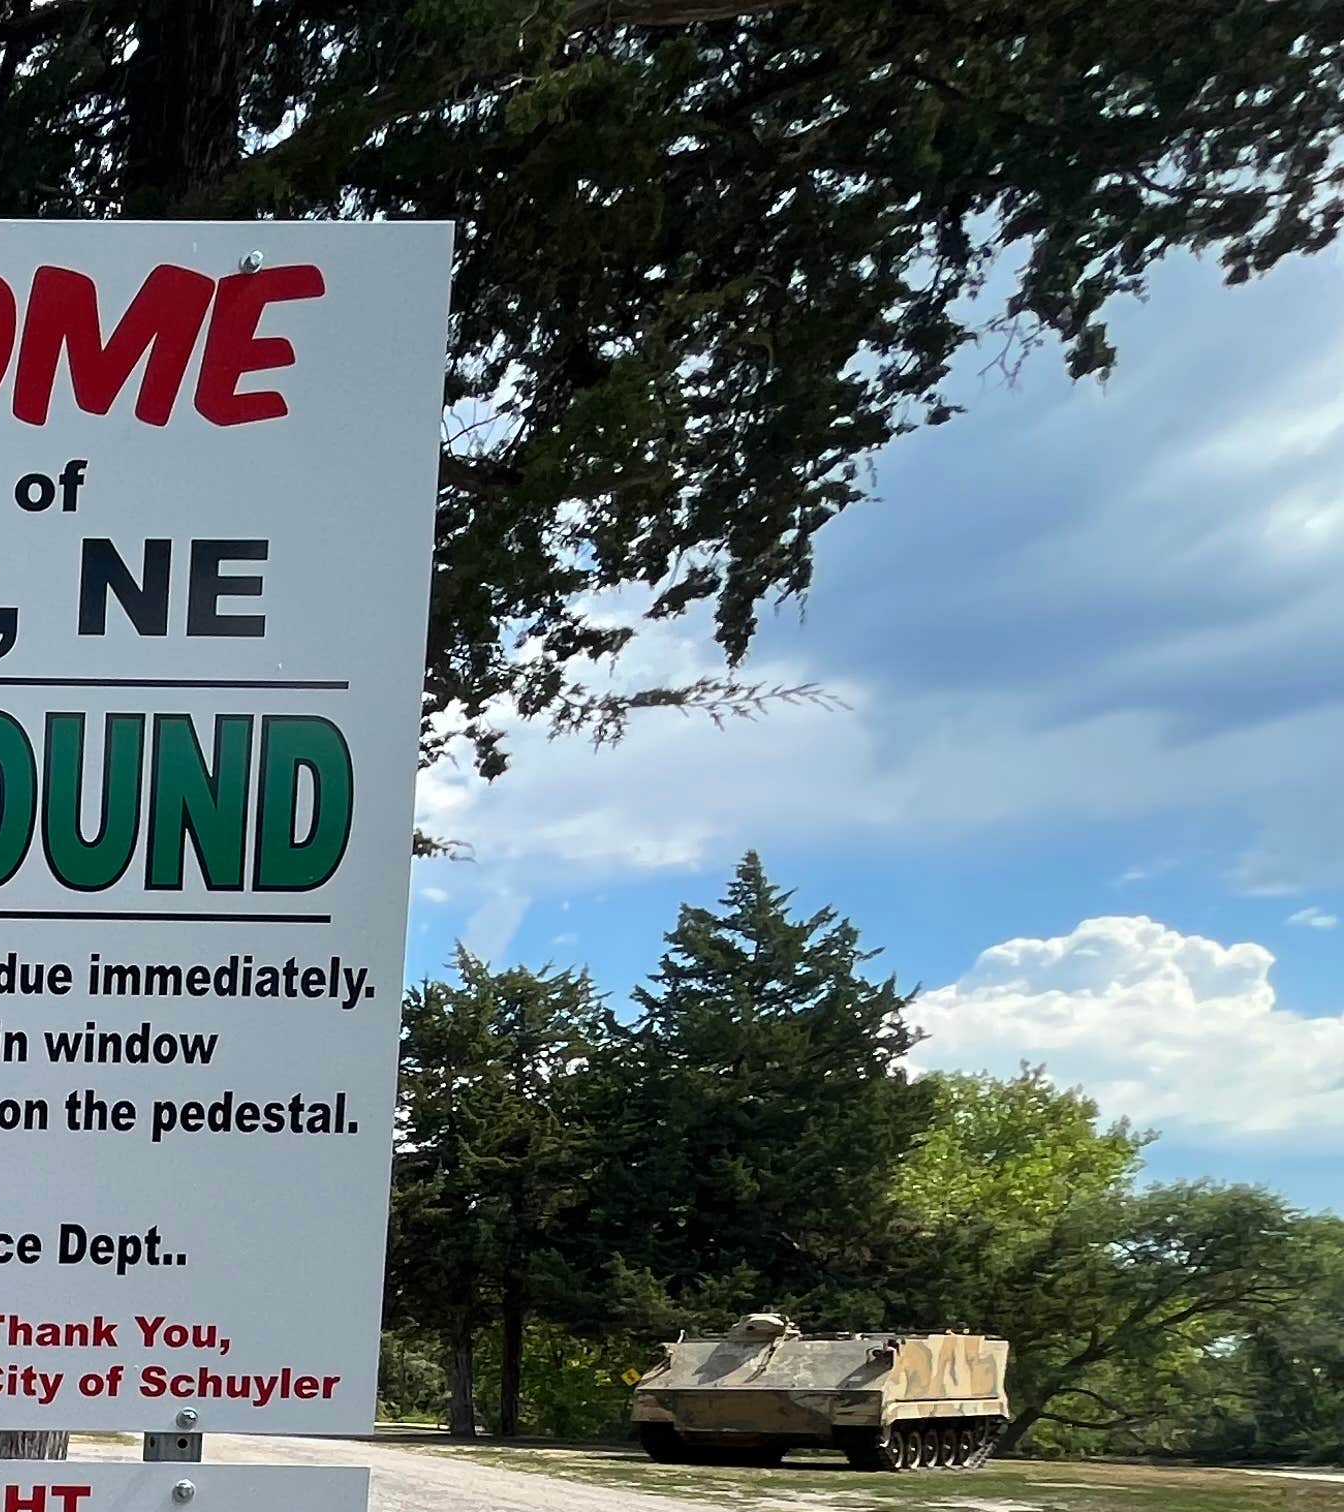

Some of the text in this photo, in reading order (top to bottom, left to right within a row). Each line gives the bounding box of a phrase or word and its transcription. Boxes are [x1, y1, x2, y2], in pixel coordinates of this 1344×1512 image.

[15, 460, 87, 512] of
[78, 538, 269, 637] NE
[90, 954, 374, 1009] immediately.
[44, 1022, 218, 1064] window
[65, 1090, 136, 1131] the
[152, 1091, 357, 1142] pedestal.
[59, 1224, 186, 1275] Dept..
[135, 1317, 230, 1355] You,
[79, 1366, 123, 1396] of
[140, 1366, 340, 1407] Schuyler
